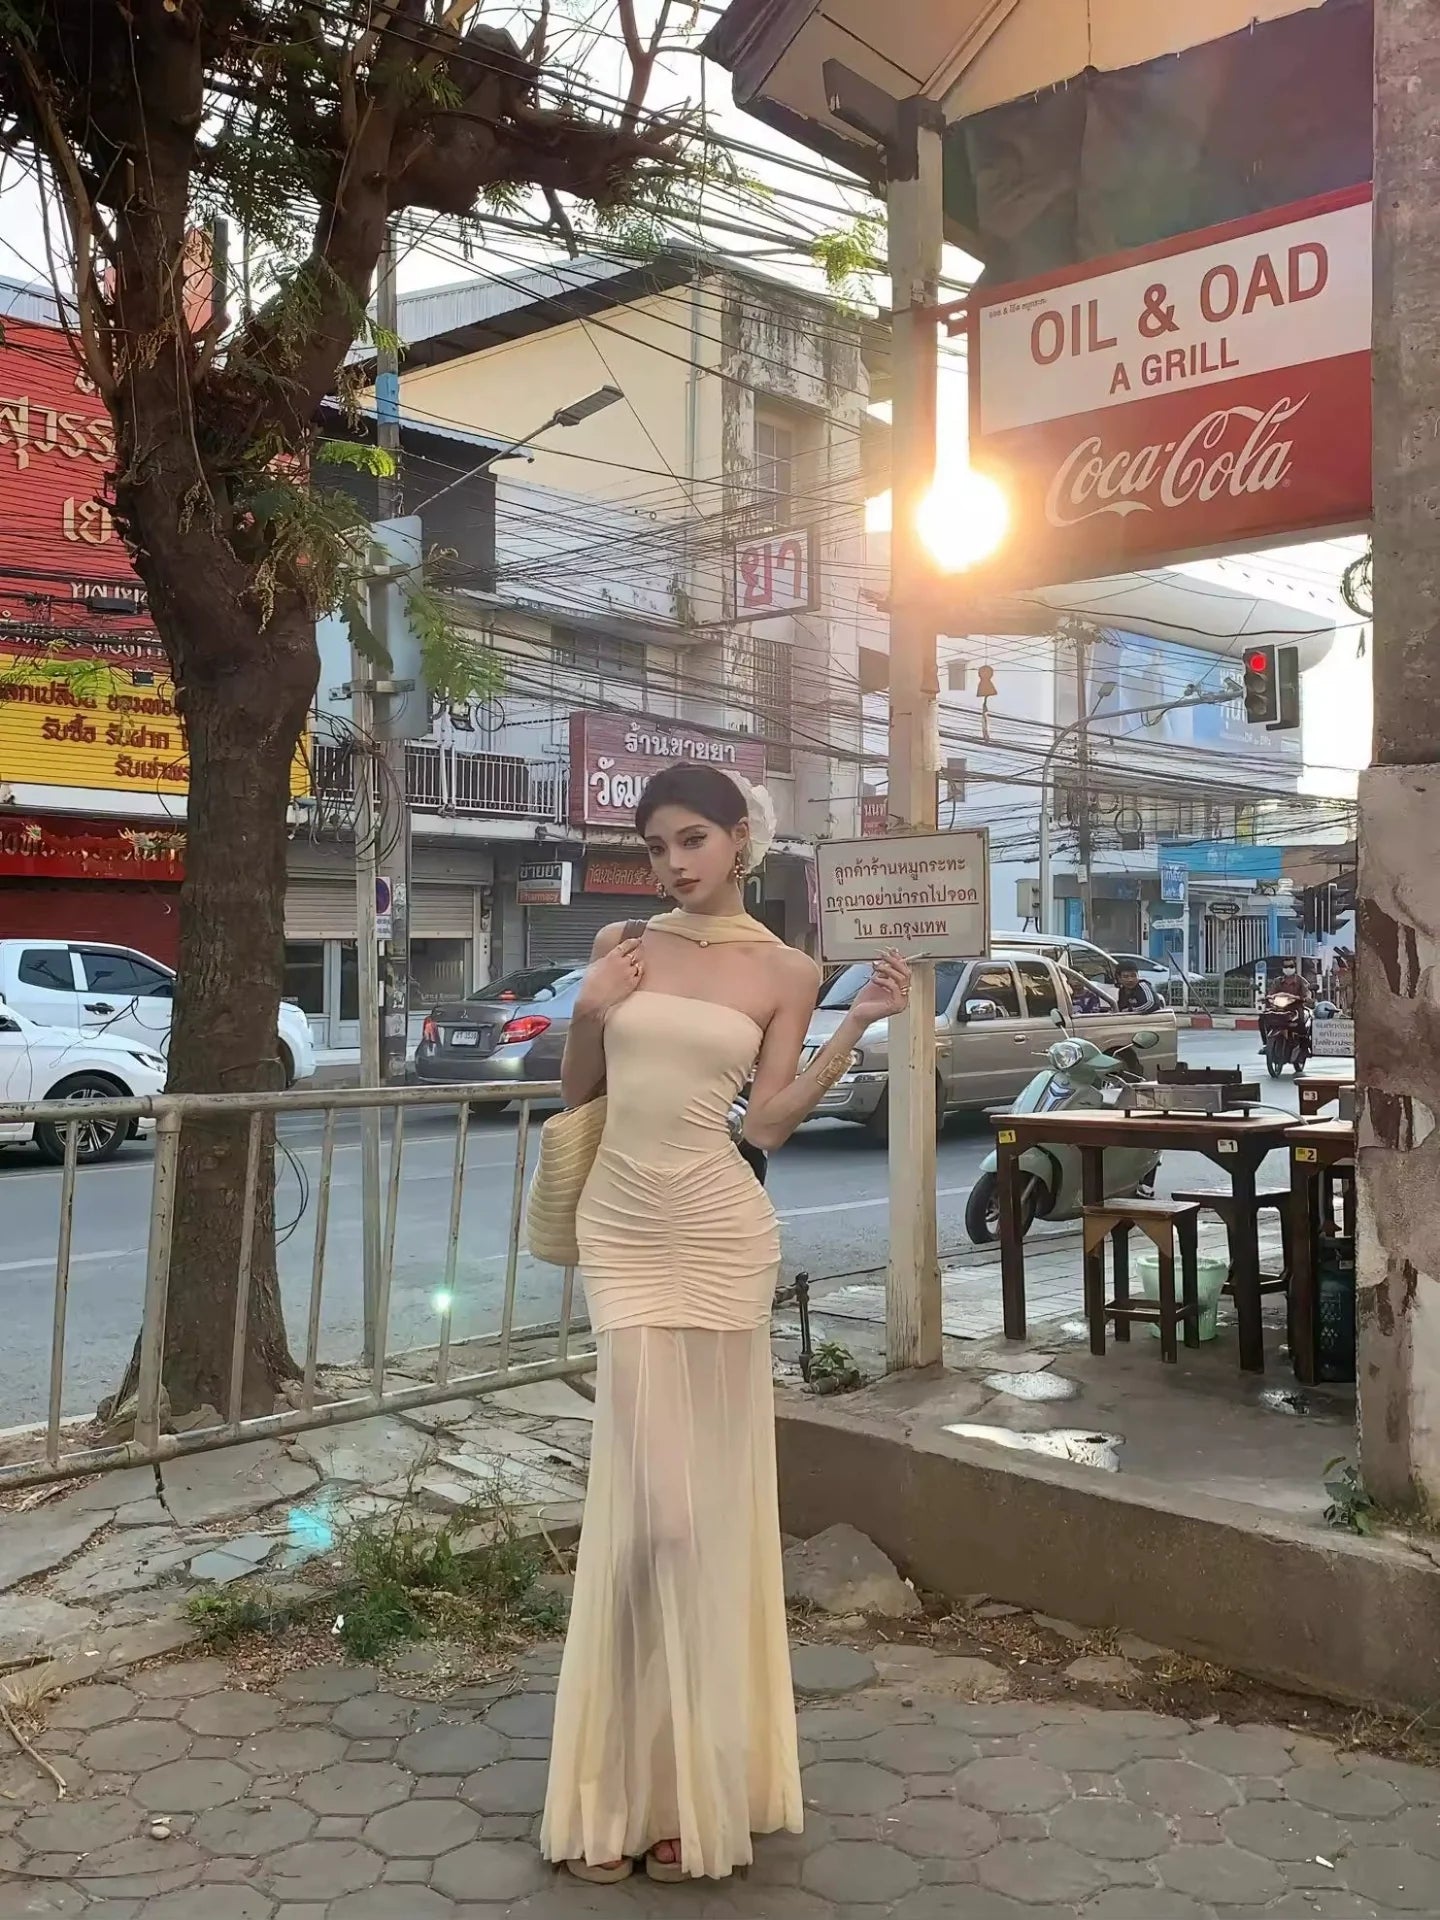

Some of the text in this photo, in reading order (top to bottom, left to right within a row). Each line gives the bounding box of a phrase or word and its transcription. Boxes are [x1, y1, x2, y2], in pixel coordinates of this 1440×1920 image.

[1031, 242, 1328, 365] OIL & OAD
[1110, 337, 1240, 394] A GRILL
[1044, 391, 1311, 528] Coca-Cola
[740, 539, 802, 607] ยา
[624, 721, 737, 763] ร้านขายยา
[520, 863, 562, 879] ขายยา
[834, 856, 967, 886] ลูกค้าร้านหมูกระทะ
[826, 883, 977, 915] กรุณาอย่านำรถไปจอด
[854, 918, 948, 941] ใน ธ.กรุงเทพ
[1008, 1132, 1014, 1142] 1
[1228, 1141, 1235, 1151] 1
[1307, 1150, 1315, 1161] 2
